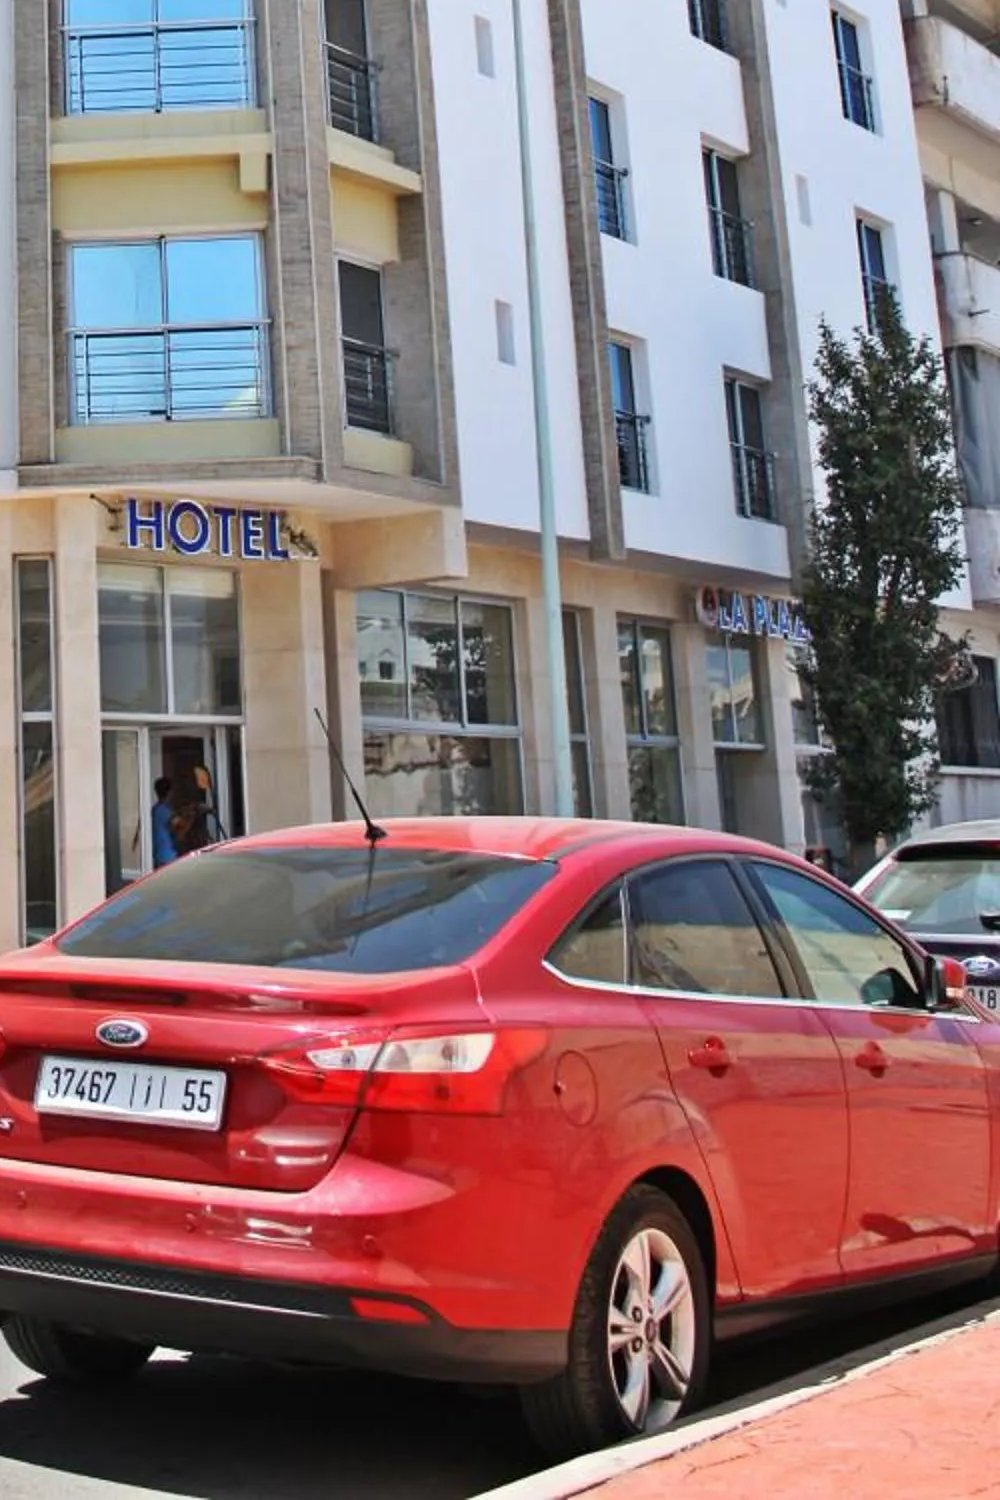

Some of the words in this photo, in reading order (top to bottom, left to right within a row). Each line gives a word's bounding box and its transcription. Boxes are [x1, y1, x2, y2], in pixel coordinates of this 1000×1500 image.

[127, 498, 290, 560] HOTEL
[718, 586, 750, 635] LA
[47, 1066, 118, 1104] 37467
[181, 1079, 213, 1113] 55
